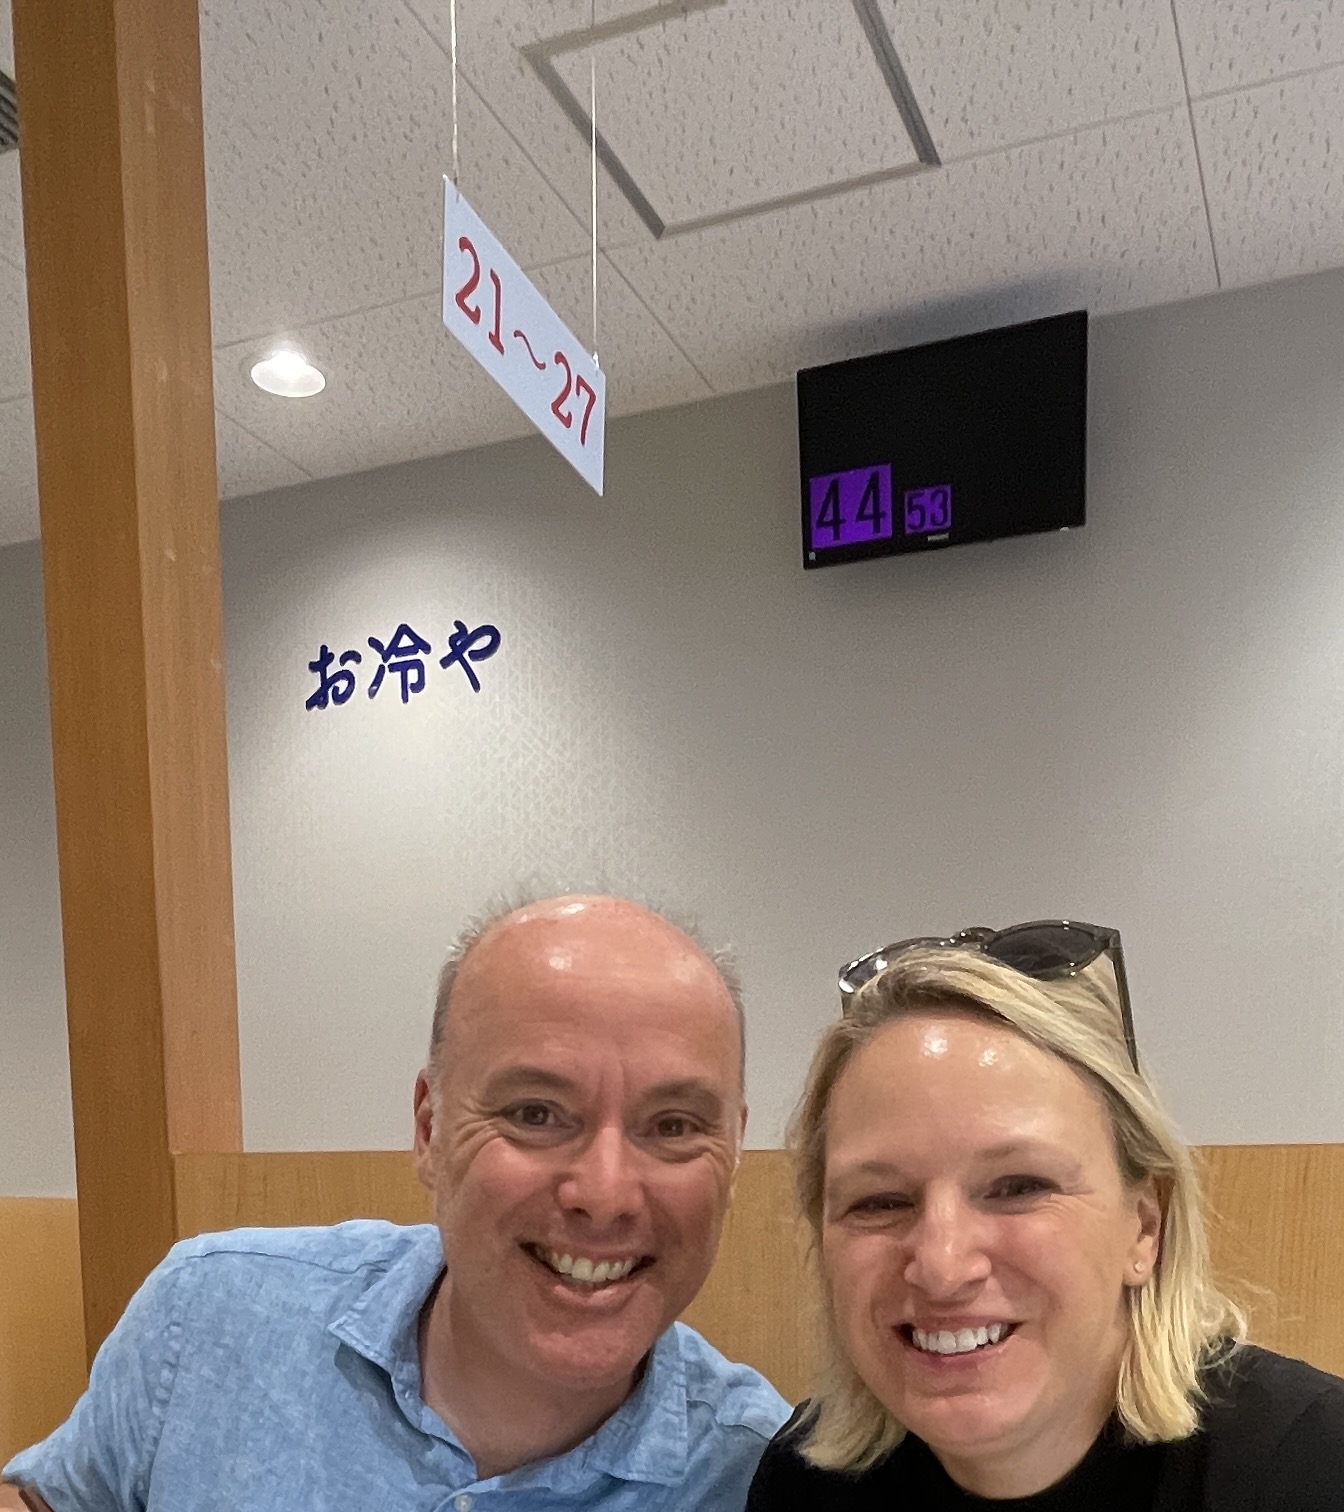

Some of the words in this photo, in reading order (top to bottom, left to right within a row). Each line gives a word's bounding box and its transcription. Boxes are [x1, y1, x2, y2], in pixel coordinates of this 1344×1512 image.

[815, 470, 886, 541] 44
[908, 488, 949, 530] 53
[304, 619, 503, 712] お冷や
